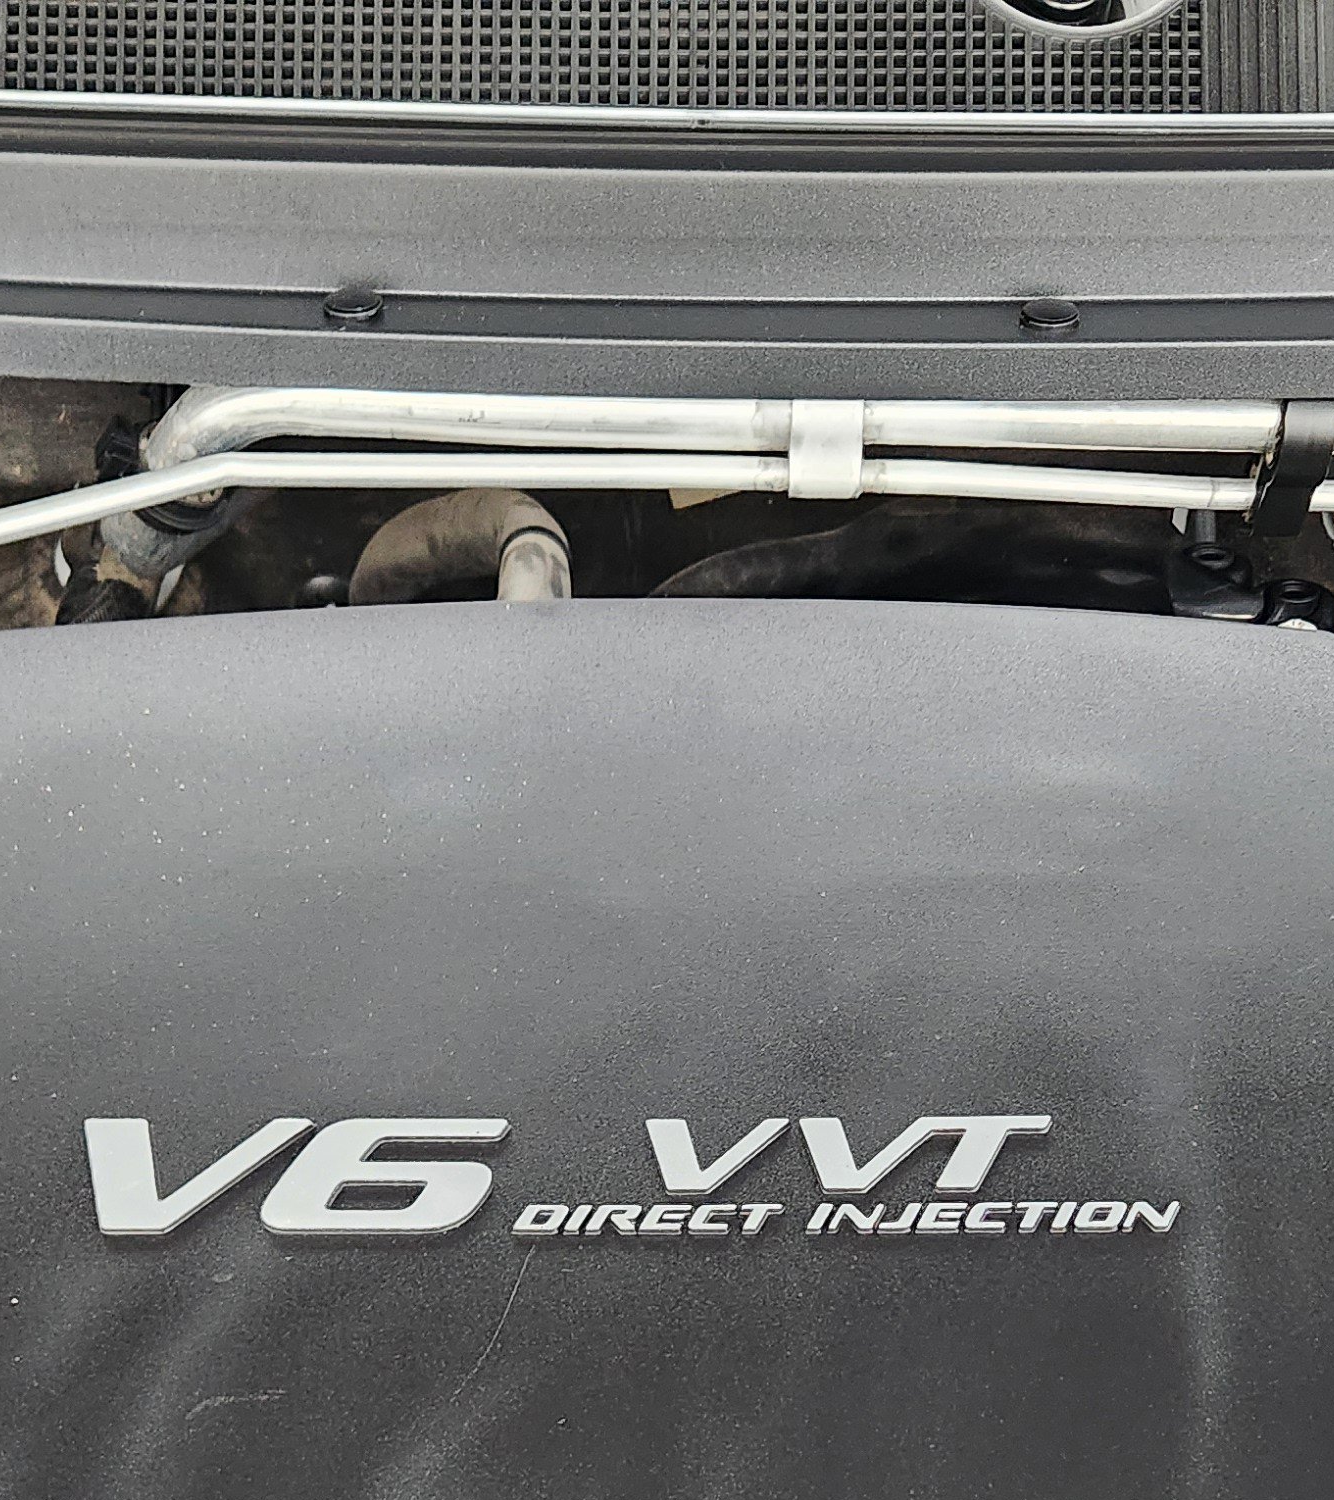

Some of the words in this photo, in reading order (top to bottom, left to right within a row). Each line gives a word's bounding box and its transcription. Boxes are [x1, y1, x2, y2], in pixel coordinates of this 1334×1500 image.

[83, 1117, 512, 1236] V6
[645, 1115, 1052, 1195] VVT
[510, 1202, 785, 1236] DIRECT
[804, 1200, 1180, 1236] INJECTION
